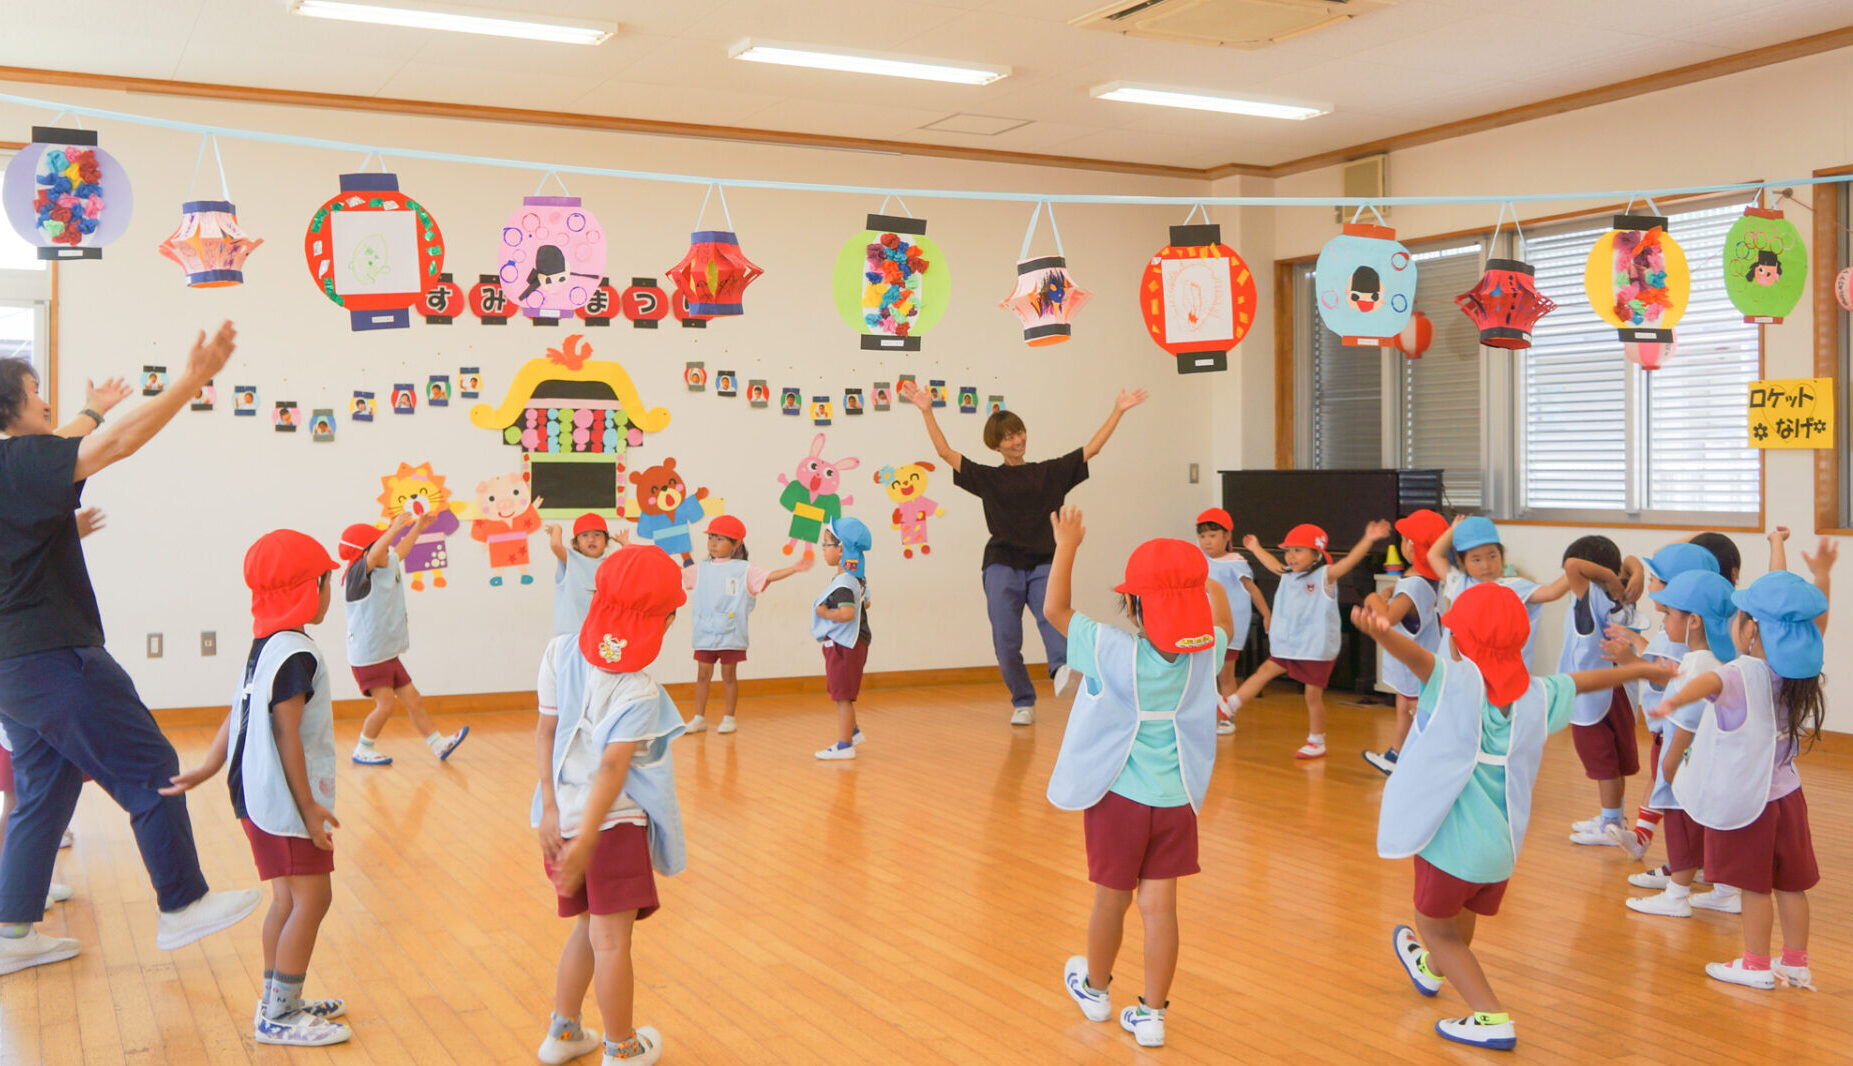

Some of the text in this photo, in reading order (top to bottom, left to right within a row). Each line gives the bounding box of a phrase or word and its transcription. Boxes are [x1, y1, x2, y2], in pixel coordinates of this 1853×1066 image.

[1749, 386, 1814, 408] ロケット
[1775, 417, 1815, 440] なげ
